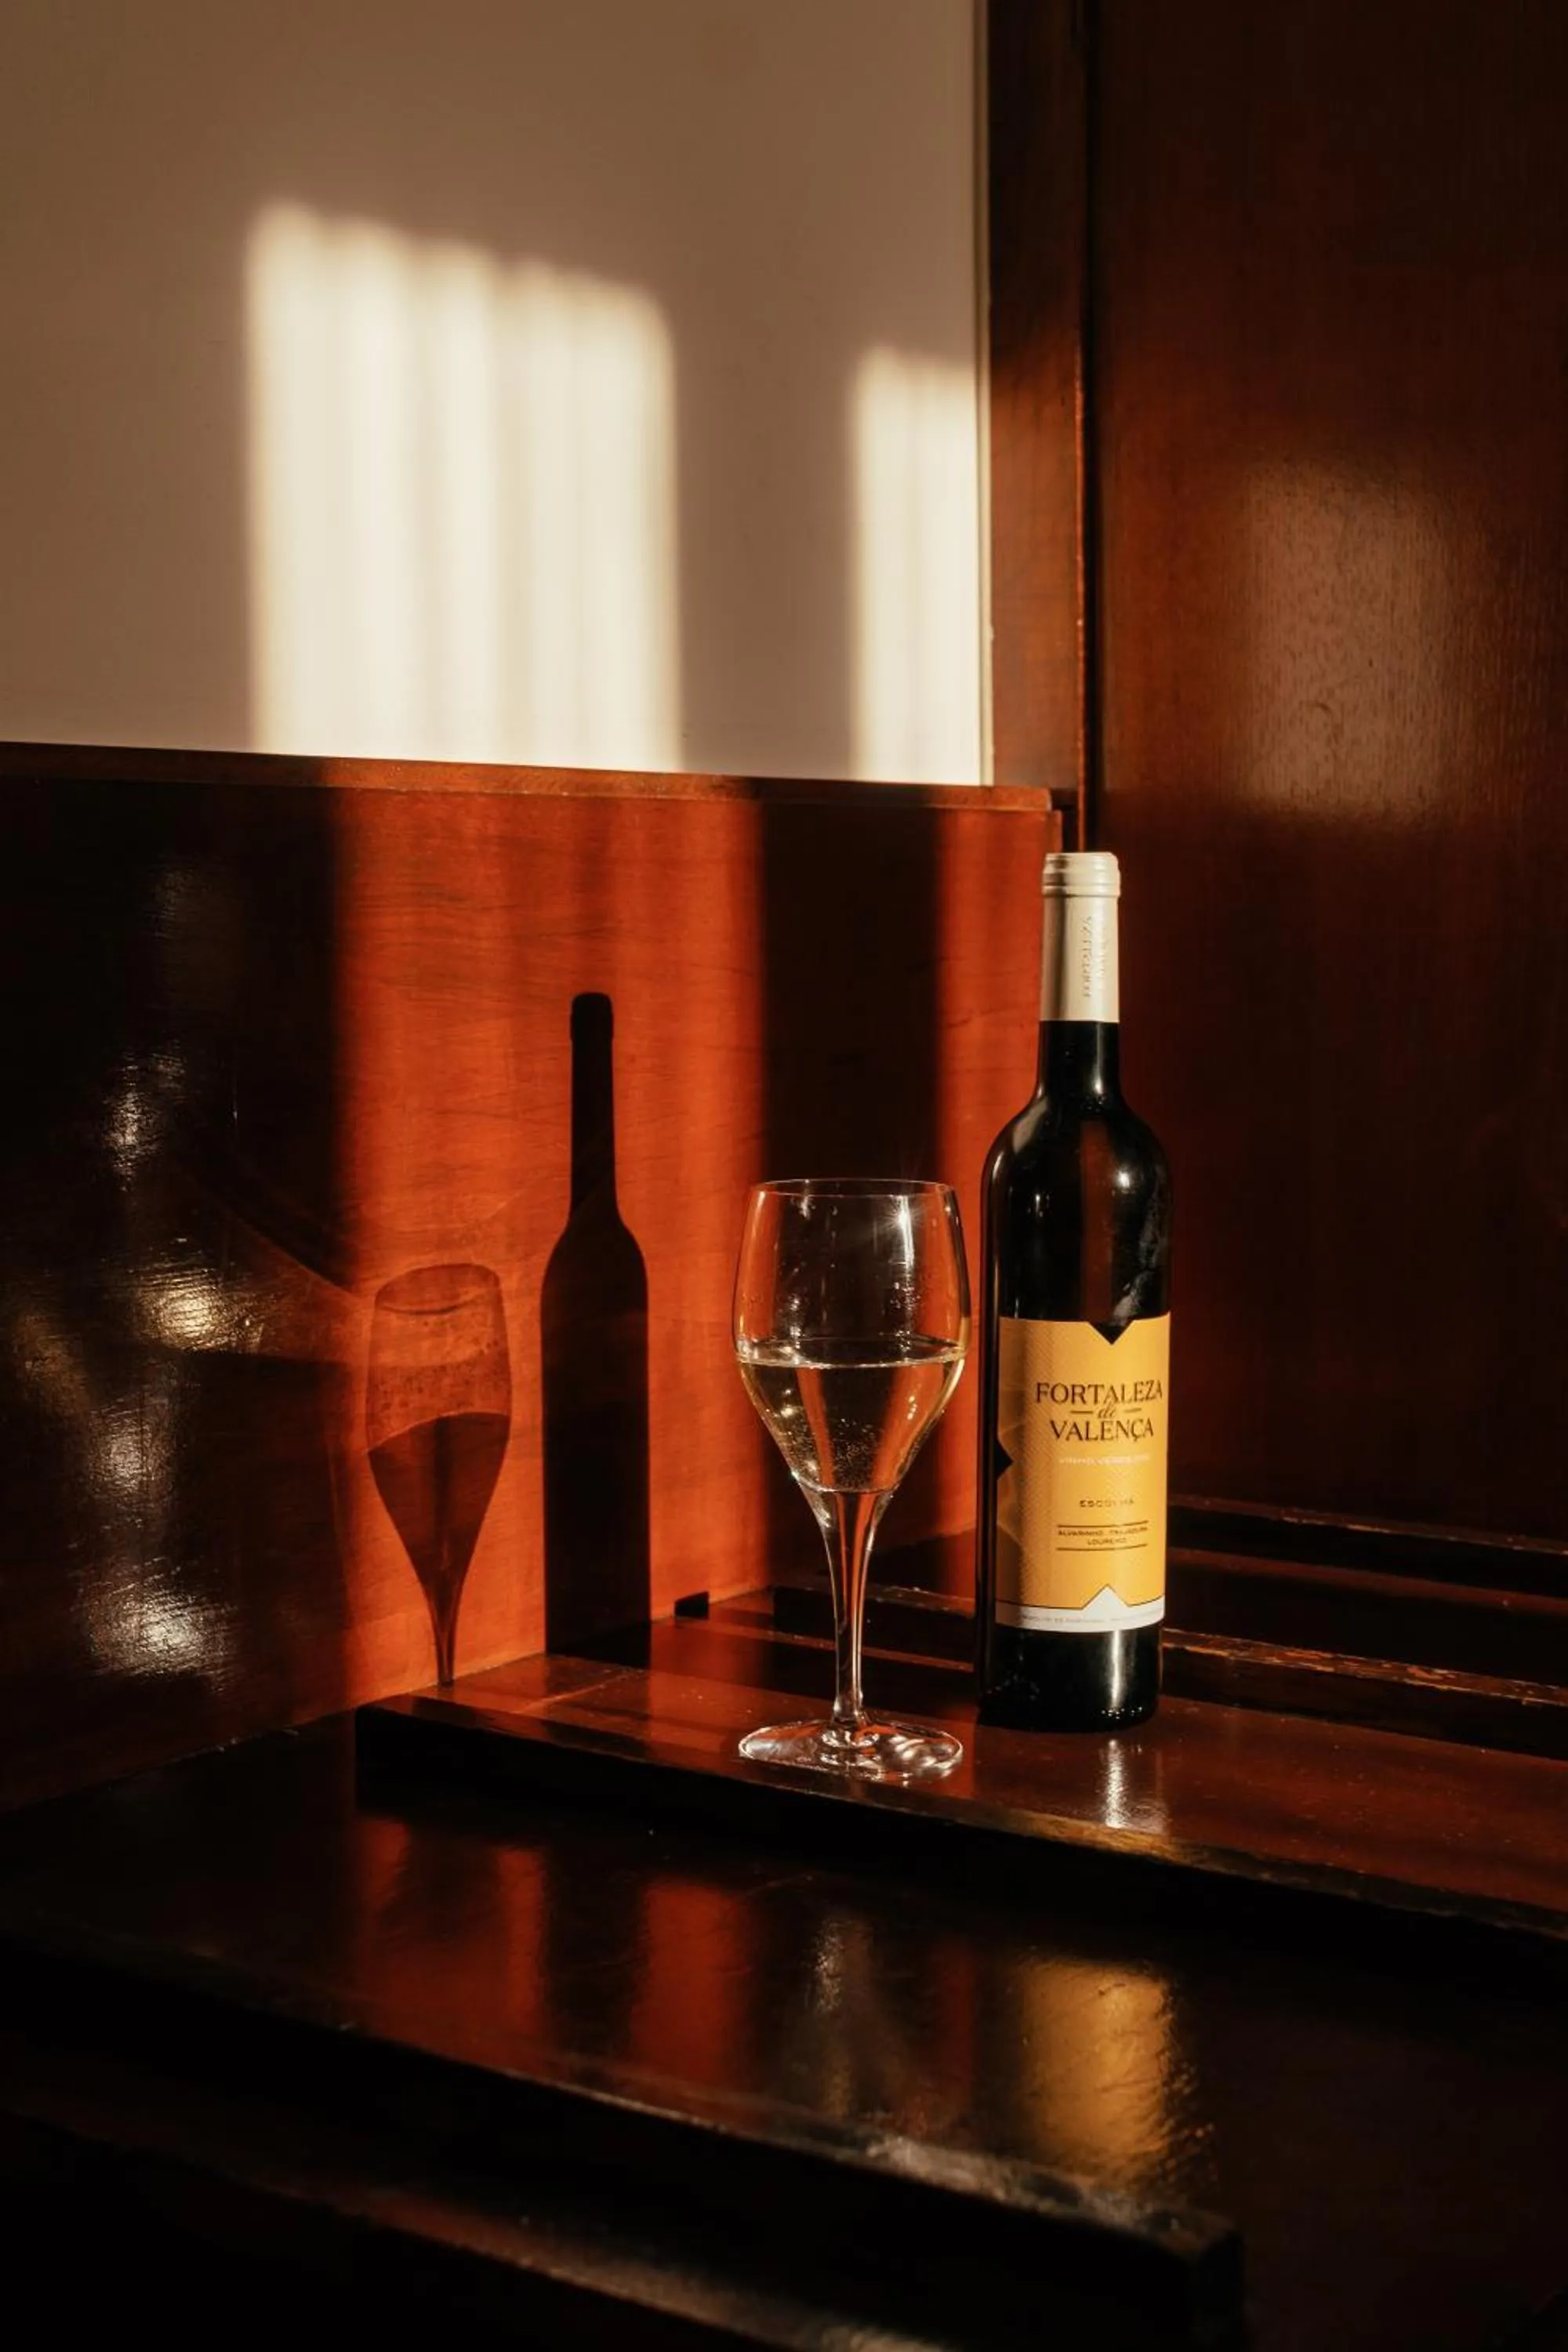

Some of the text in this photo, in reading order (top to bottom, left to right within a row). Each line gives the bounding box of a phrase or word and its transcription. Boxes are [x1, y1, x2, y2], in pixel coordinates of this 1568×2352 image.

[1035, 1379, 1163, 1405] FORTALEZA
[1097, 1399, 1117, 1419] de
[1049, 1416, 1155, 1443] VALENÇA
